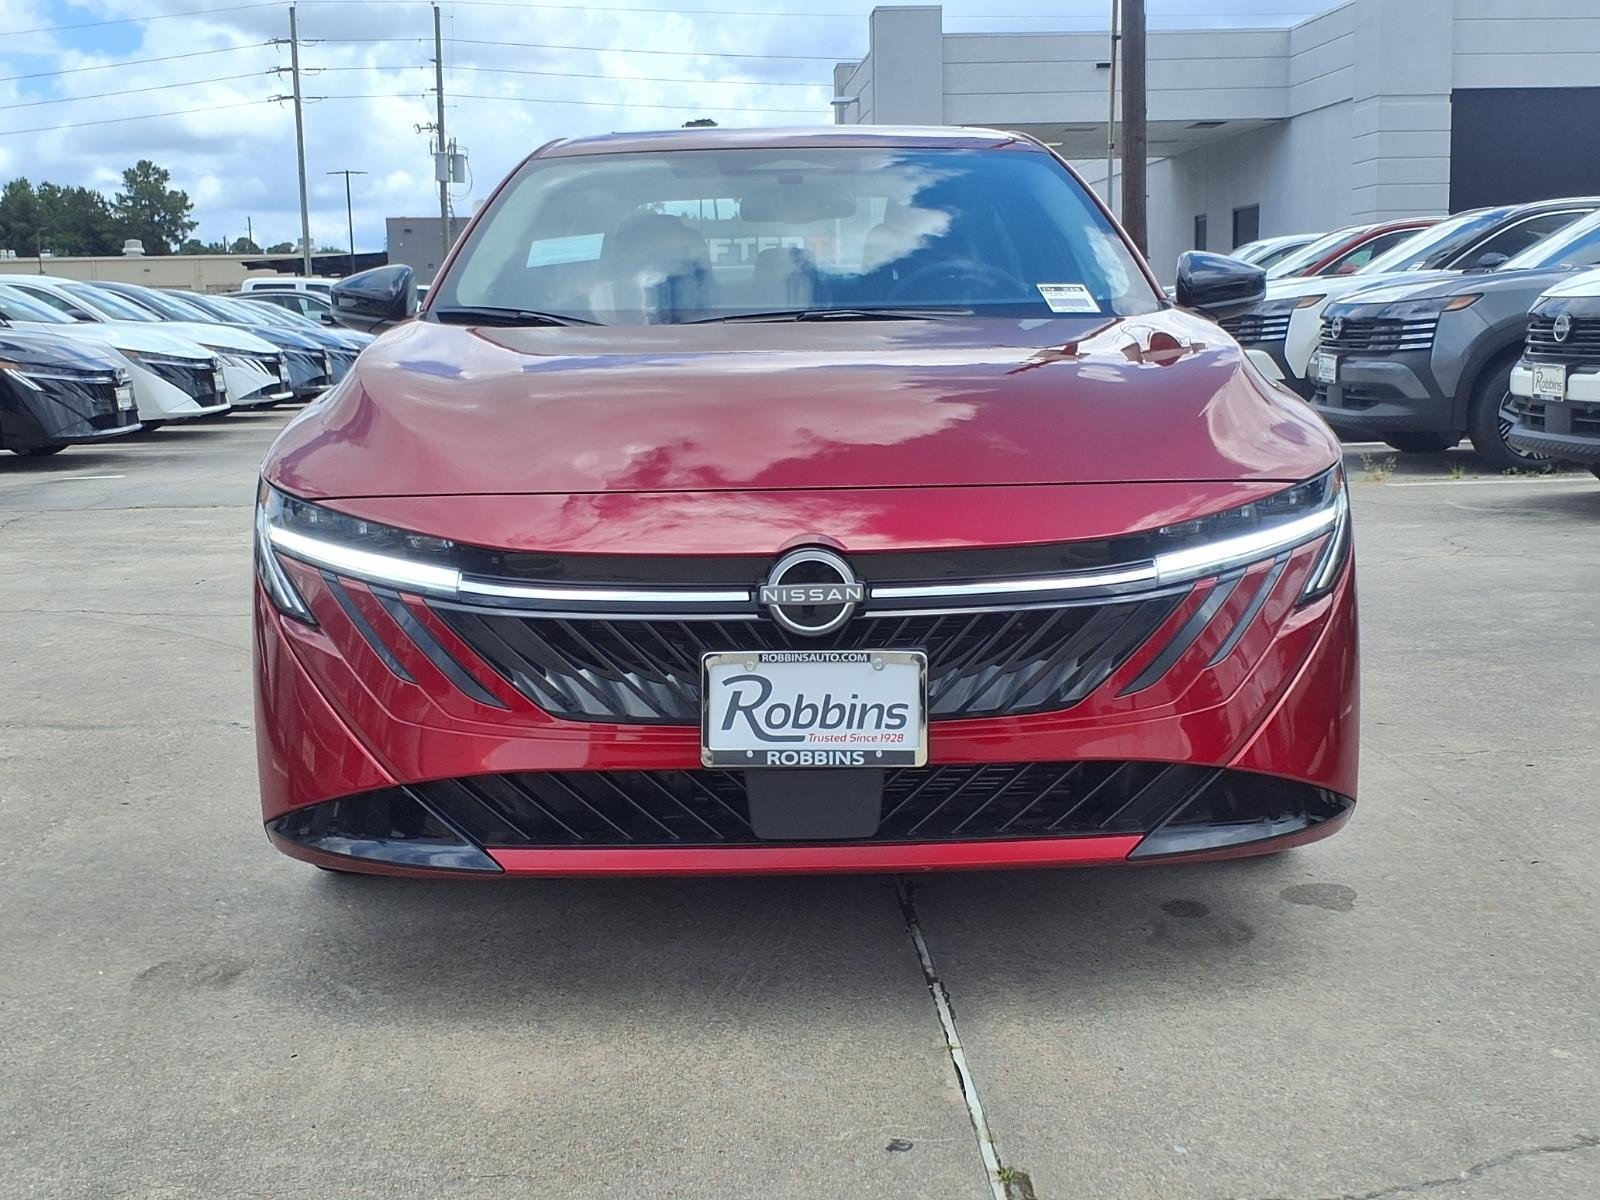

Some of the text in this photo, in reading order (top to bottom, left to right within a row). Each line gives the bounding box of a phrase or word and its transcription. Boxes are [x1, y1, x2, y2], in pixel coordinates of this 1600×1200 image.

[1535, 371, 1563, 393] Robbins
[763, 587, 860, 602] NISSAN
[761, 653, 868, 663] ROBBINSAUTO.COM
[721, 674, 909, 743] Robbins
[808, 732, 904, 743] Trusted Since 1928
[766, 750, 865, 766] ROBBINS
